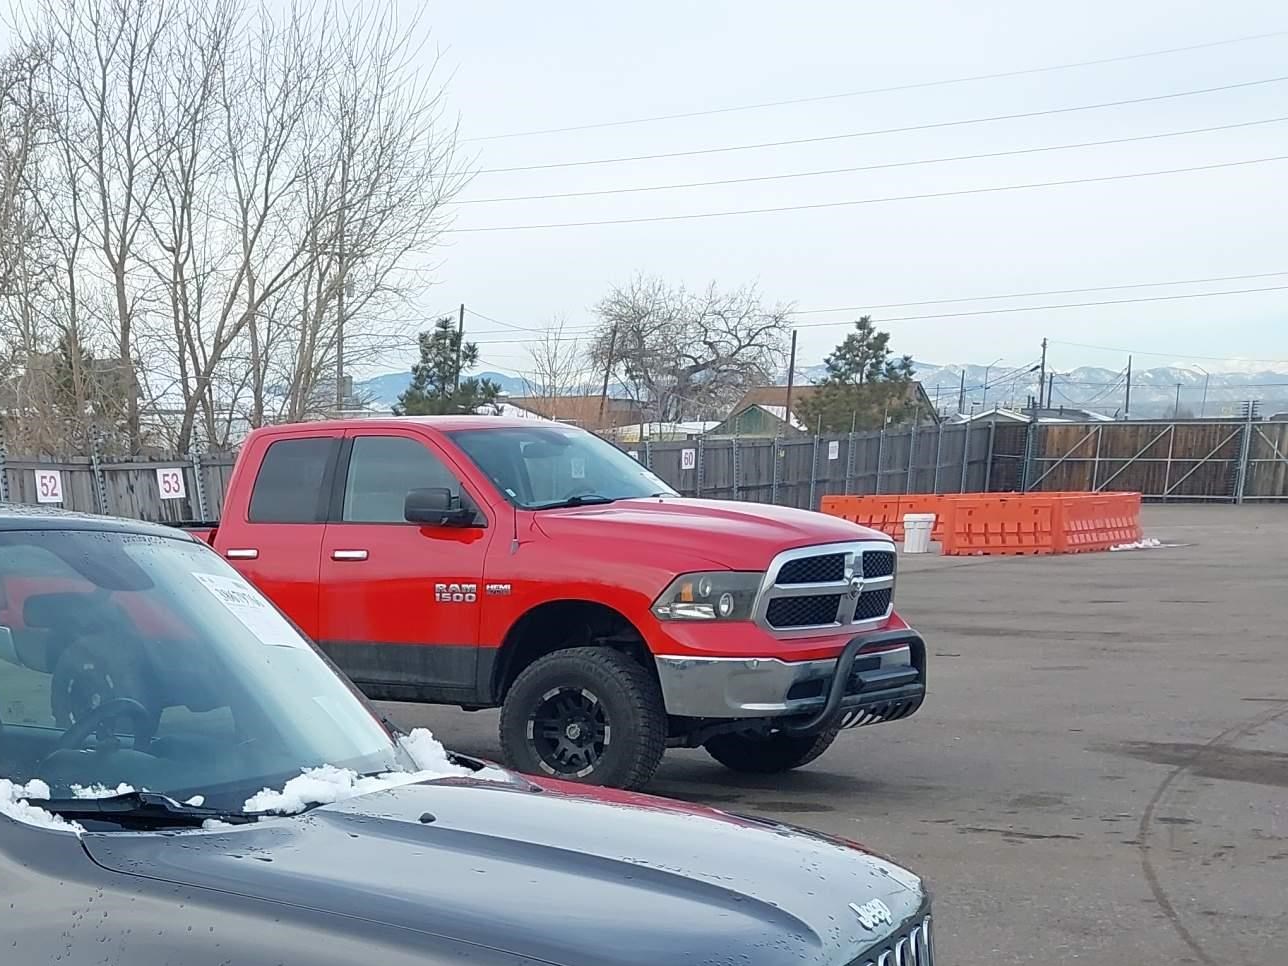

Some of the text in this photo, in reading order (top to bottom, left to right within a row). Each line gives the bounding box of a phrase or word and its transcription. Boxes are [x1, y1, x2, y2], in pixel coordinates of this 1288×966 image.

[683, 451, 694, 466] 60
[40, 475, 59, 497] 52
[162, 472, 181, 494] 53
[434, 583, 477, 593] RAM
[434, 593, 477, 602] 1500
[848, 898, 893, 929] Jeep
